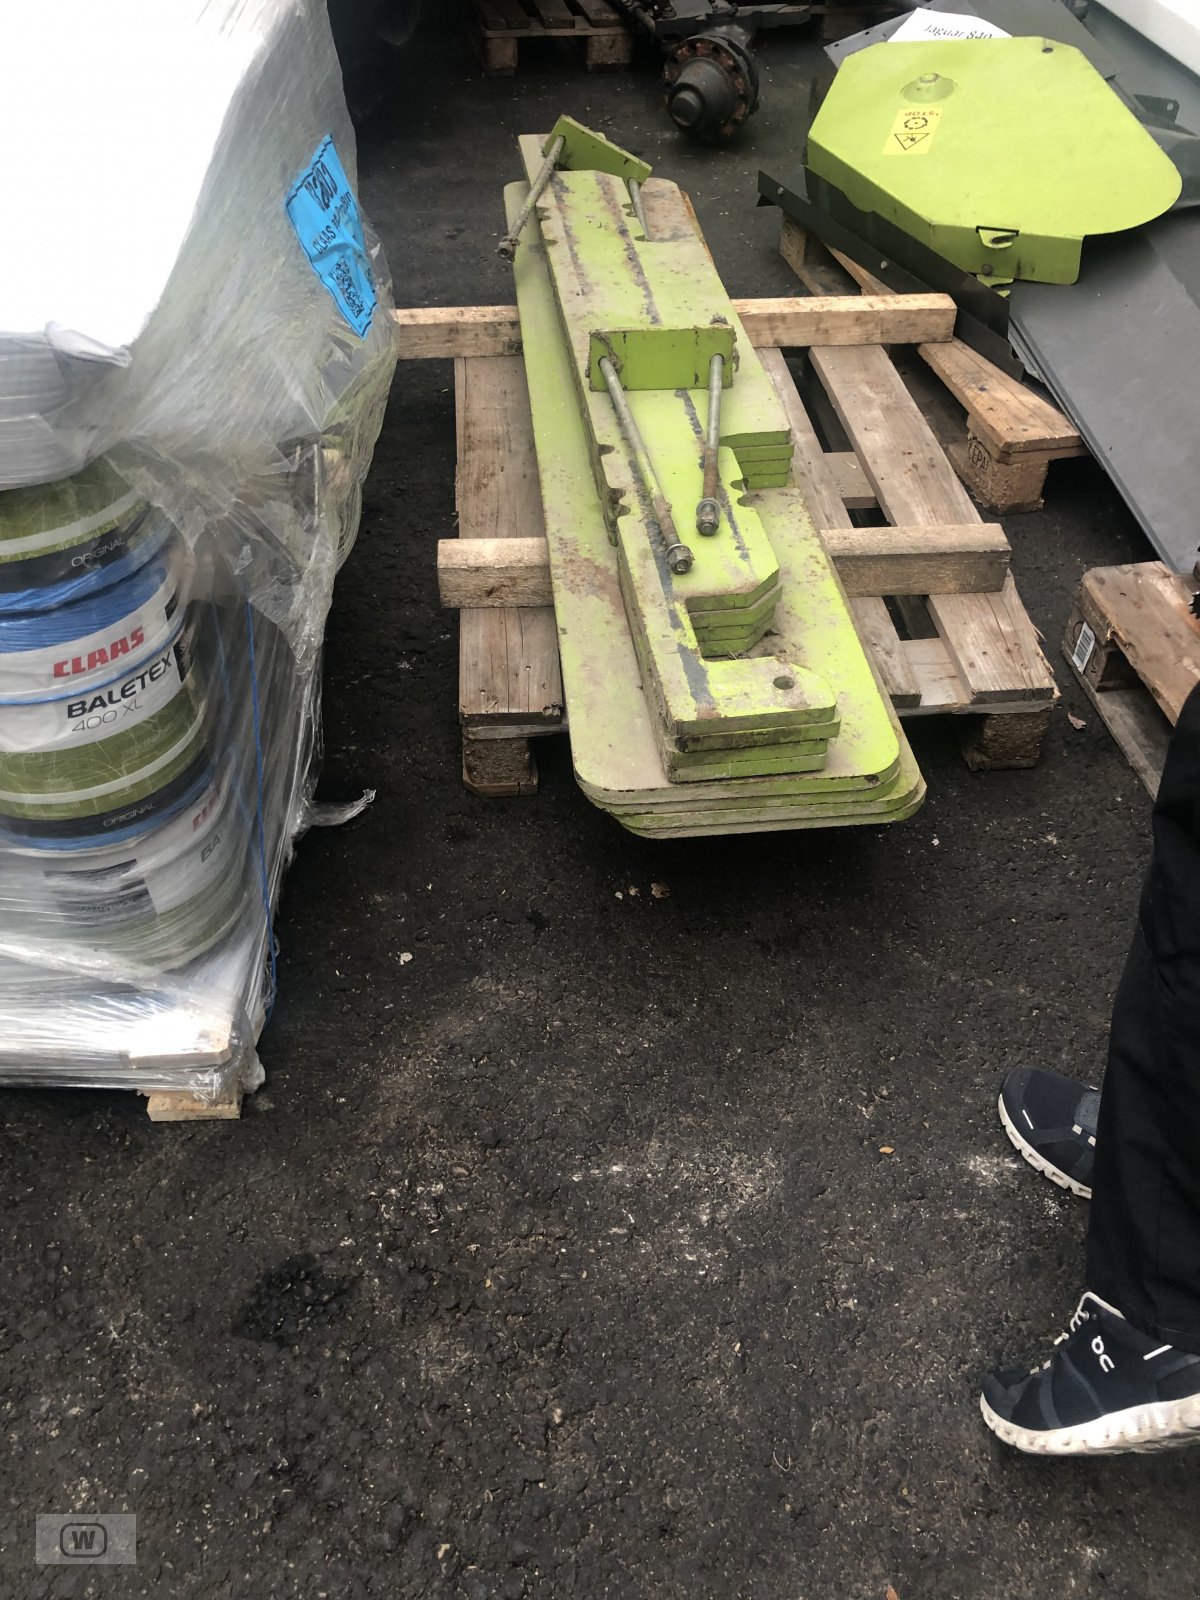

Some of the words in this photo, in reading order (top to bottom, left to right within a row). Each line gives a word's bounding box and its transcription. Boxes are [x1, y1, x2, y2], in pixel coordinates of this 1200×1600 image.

[312, 224, 337, 255] CLAAS
[71, 537, 125, 567] ORIGINAL
[53, 625, 145, 679] CLAAS
[67, 651, 173, 719] BALETEX
[71, 709, 118, 732] 400
[122, 698, 143, 716] XL
[102, 802, 156, 828] ORIGINAL
